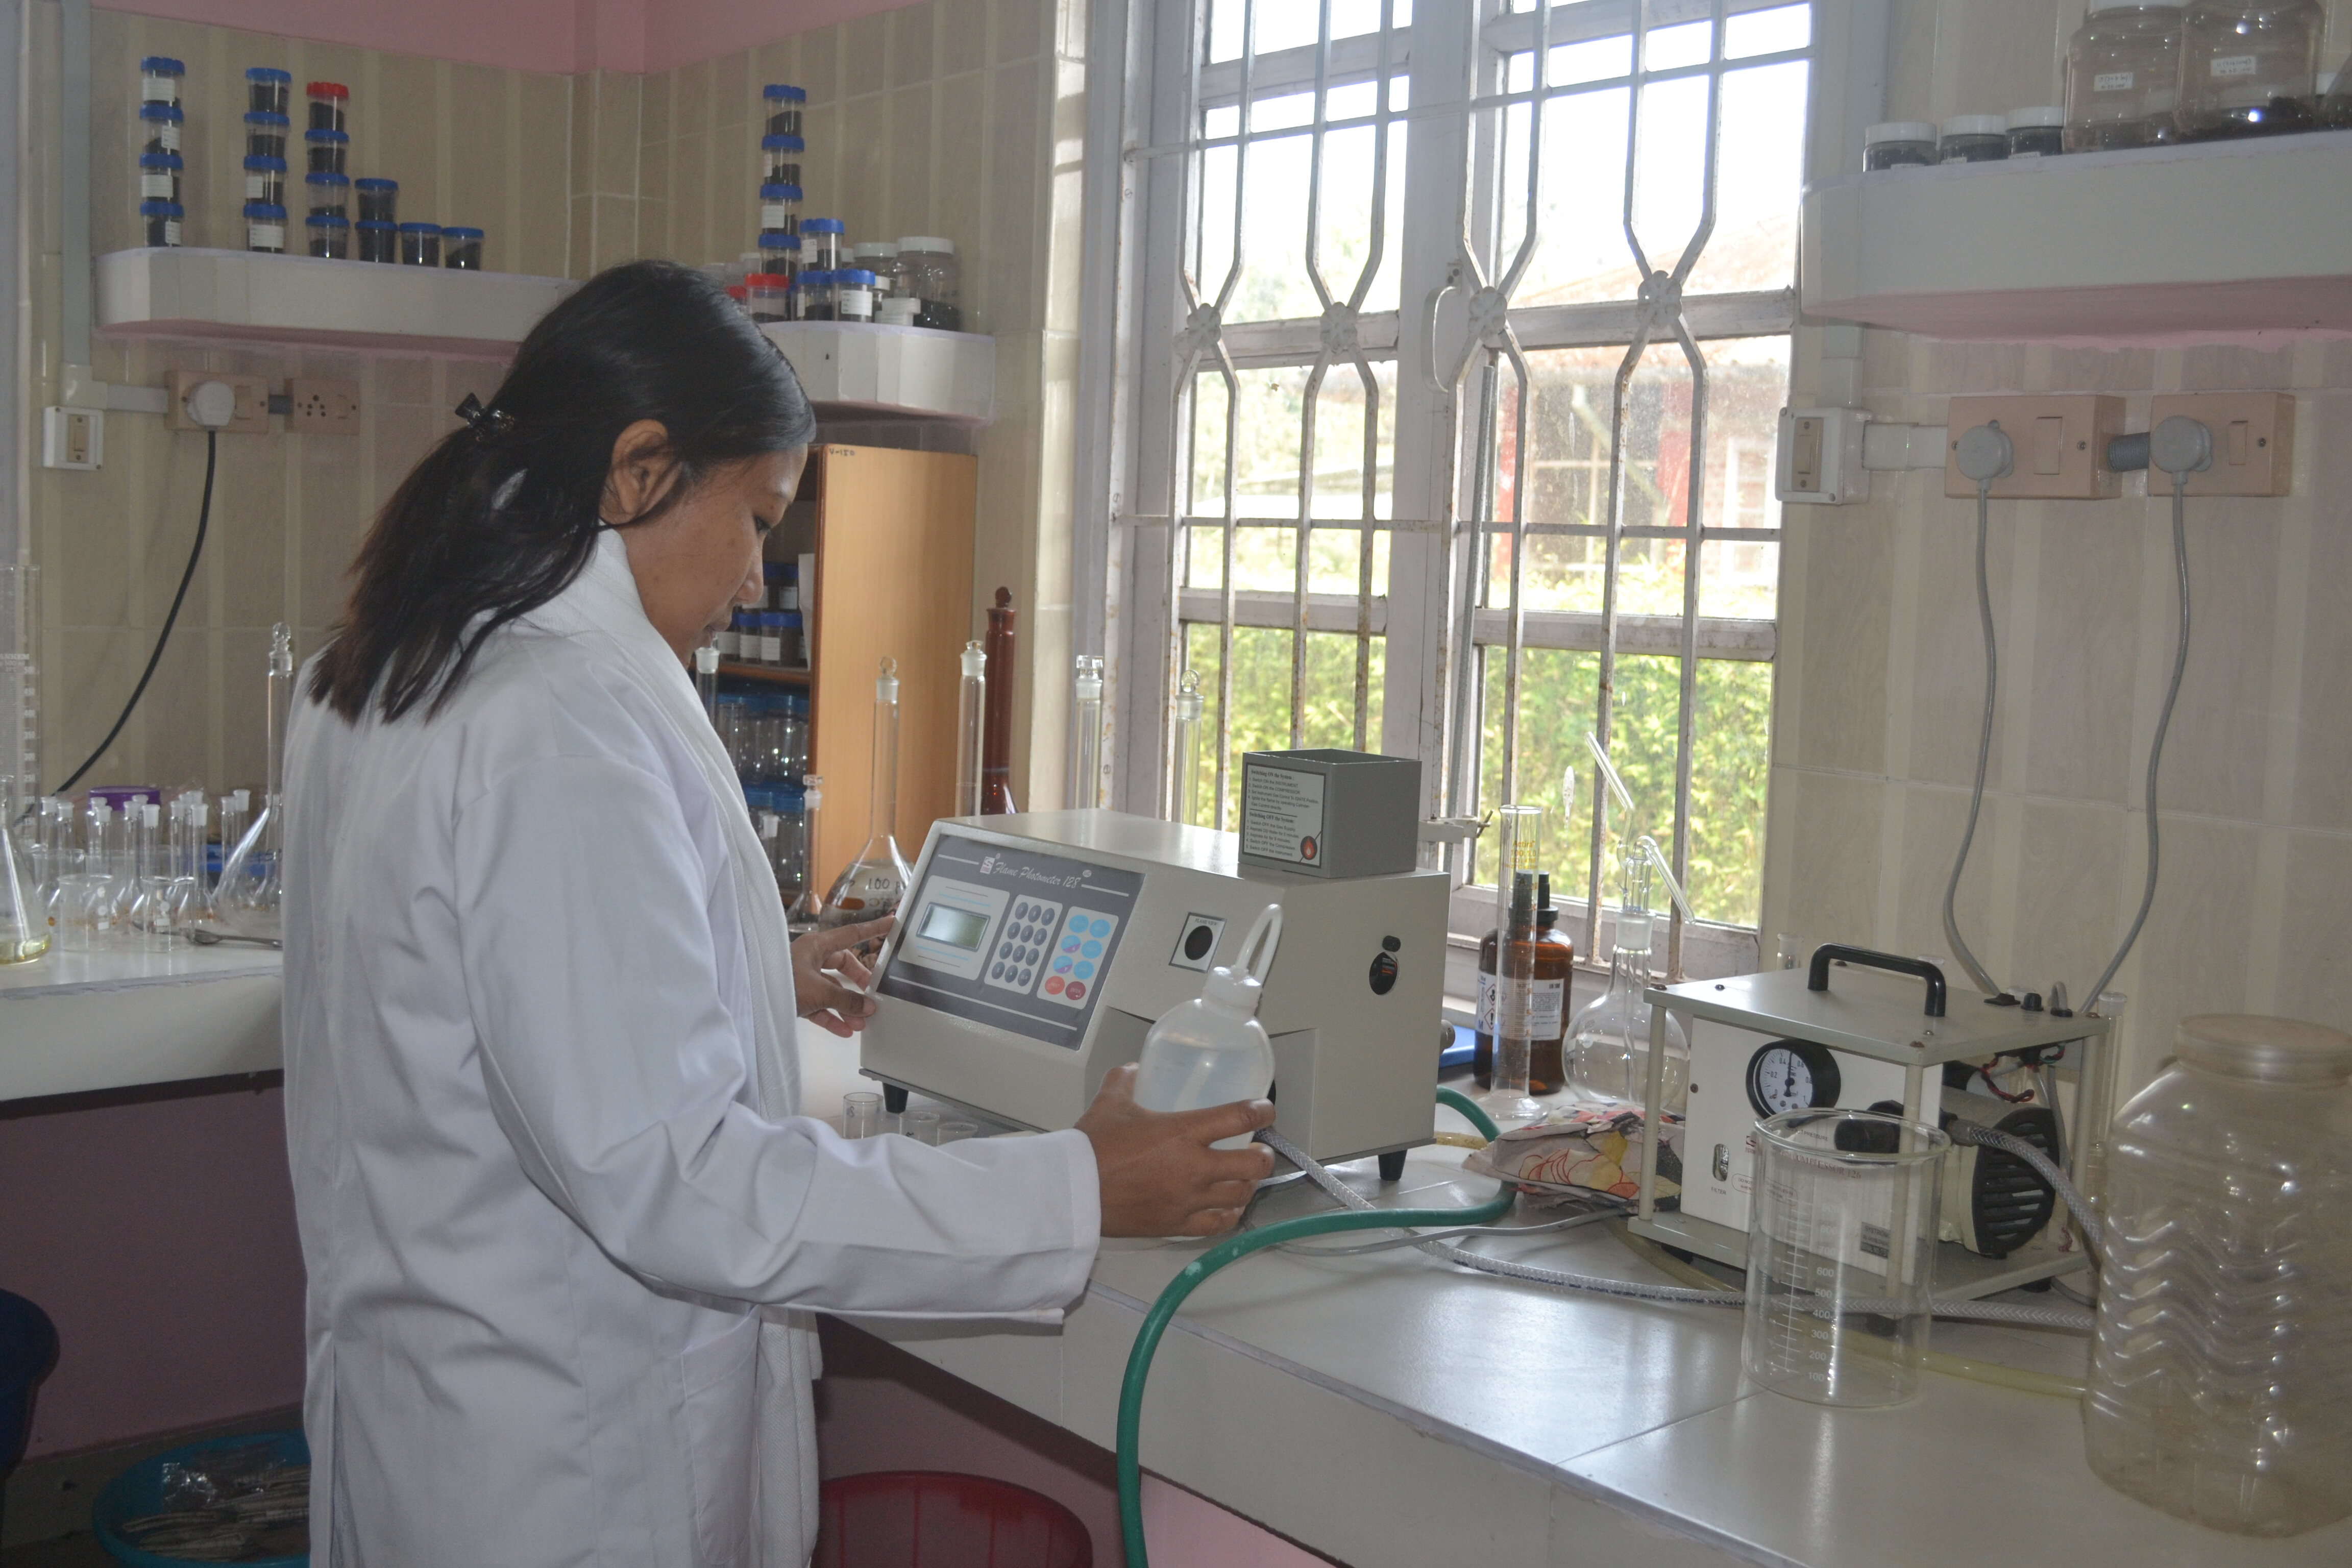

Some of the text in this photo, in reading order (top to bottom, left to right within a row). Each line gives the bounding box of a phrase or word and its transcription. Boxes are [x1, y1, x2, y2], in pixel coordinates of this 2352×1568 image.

[993, 862, 1081, 888] Flame Photometer 128
[868, 878, 890, 889] 100
[1711, 1187, 1727, 1195] FILTER
[1817, 1266, 1834, 1277] 600
[1815, 1288, 1832, 1298] 500
[1812, 1309, 1830, 1319] 400
[1811, 1330, 1828, 1340] 300
[1809, 1351, 1827, 1361] 200
[1808, 1371, 1824, 1382] 100
